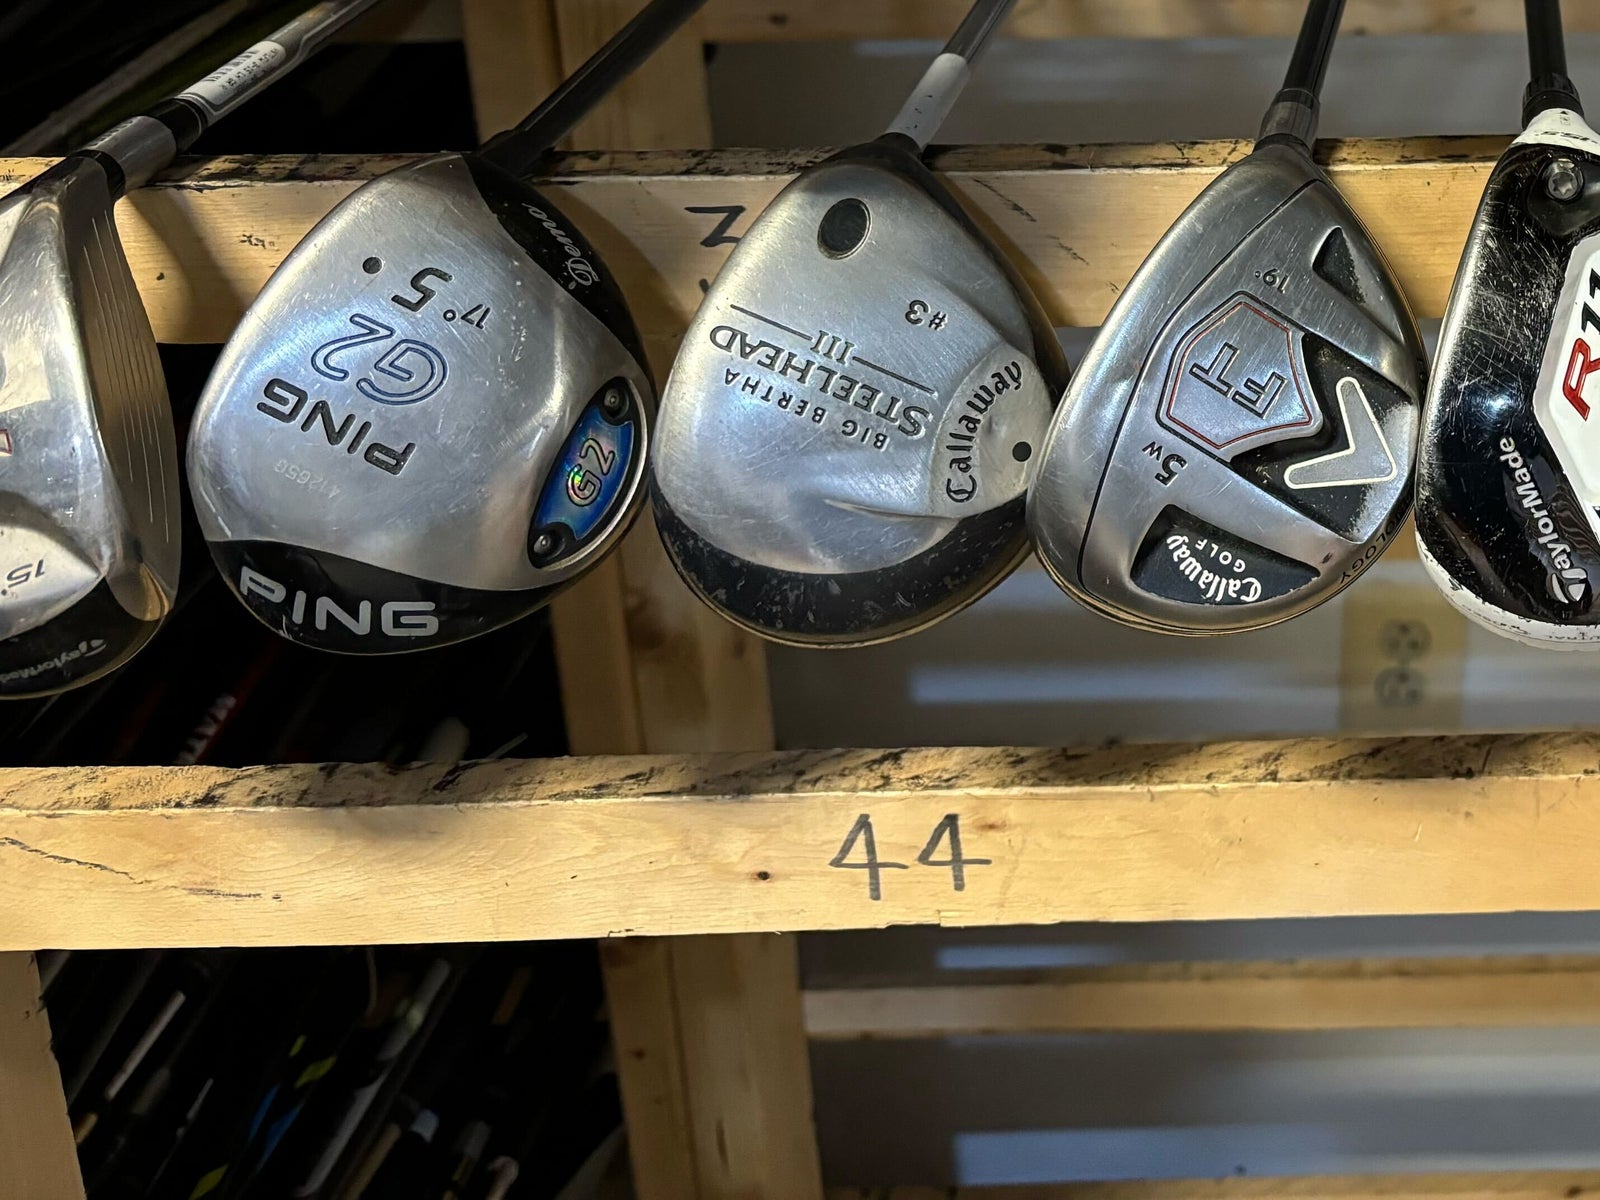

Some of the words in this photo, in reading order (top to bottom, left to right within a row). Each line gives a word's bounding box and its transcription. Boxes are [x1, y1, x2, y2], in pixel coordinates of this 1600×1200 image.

[522, 202, 601, 287] Demo
[390, 266, 454, 313] 5
[311, 313, 449, 406] G2
[708, 324, 936, 440] STEELHEAD
[723, 367, 829, 427] BERTHA
[1188, 342, 1288, 420] FT
[256, 377, 417, 477] PING
[841, 418, 892, 452] BIG
[945, 360, 1024, 504] Callaway
[566, 437, 616, 506] G2
[1194, 537, 1248, 574] GOLF
[1499, 436, 1591, 605] TaylorMade
[239, 566, 440, 638] PING
[1165, 534, 1264, 603] Callaway
